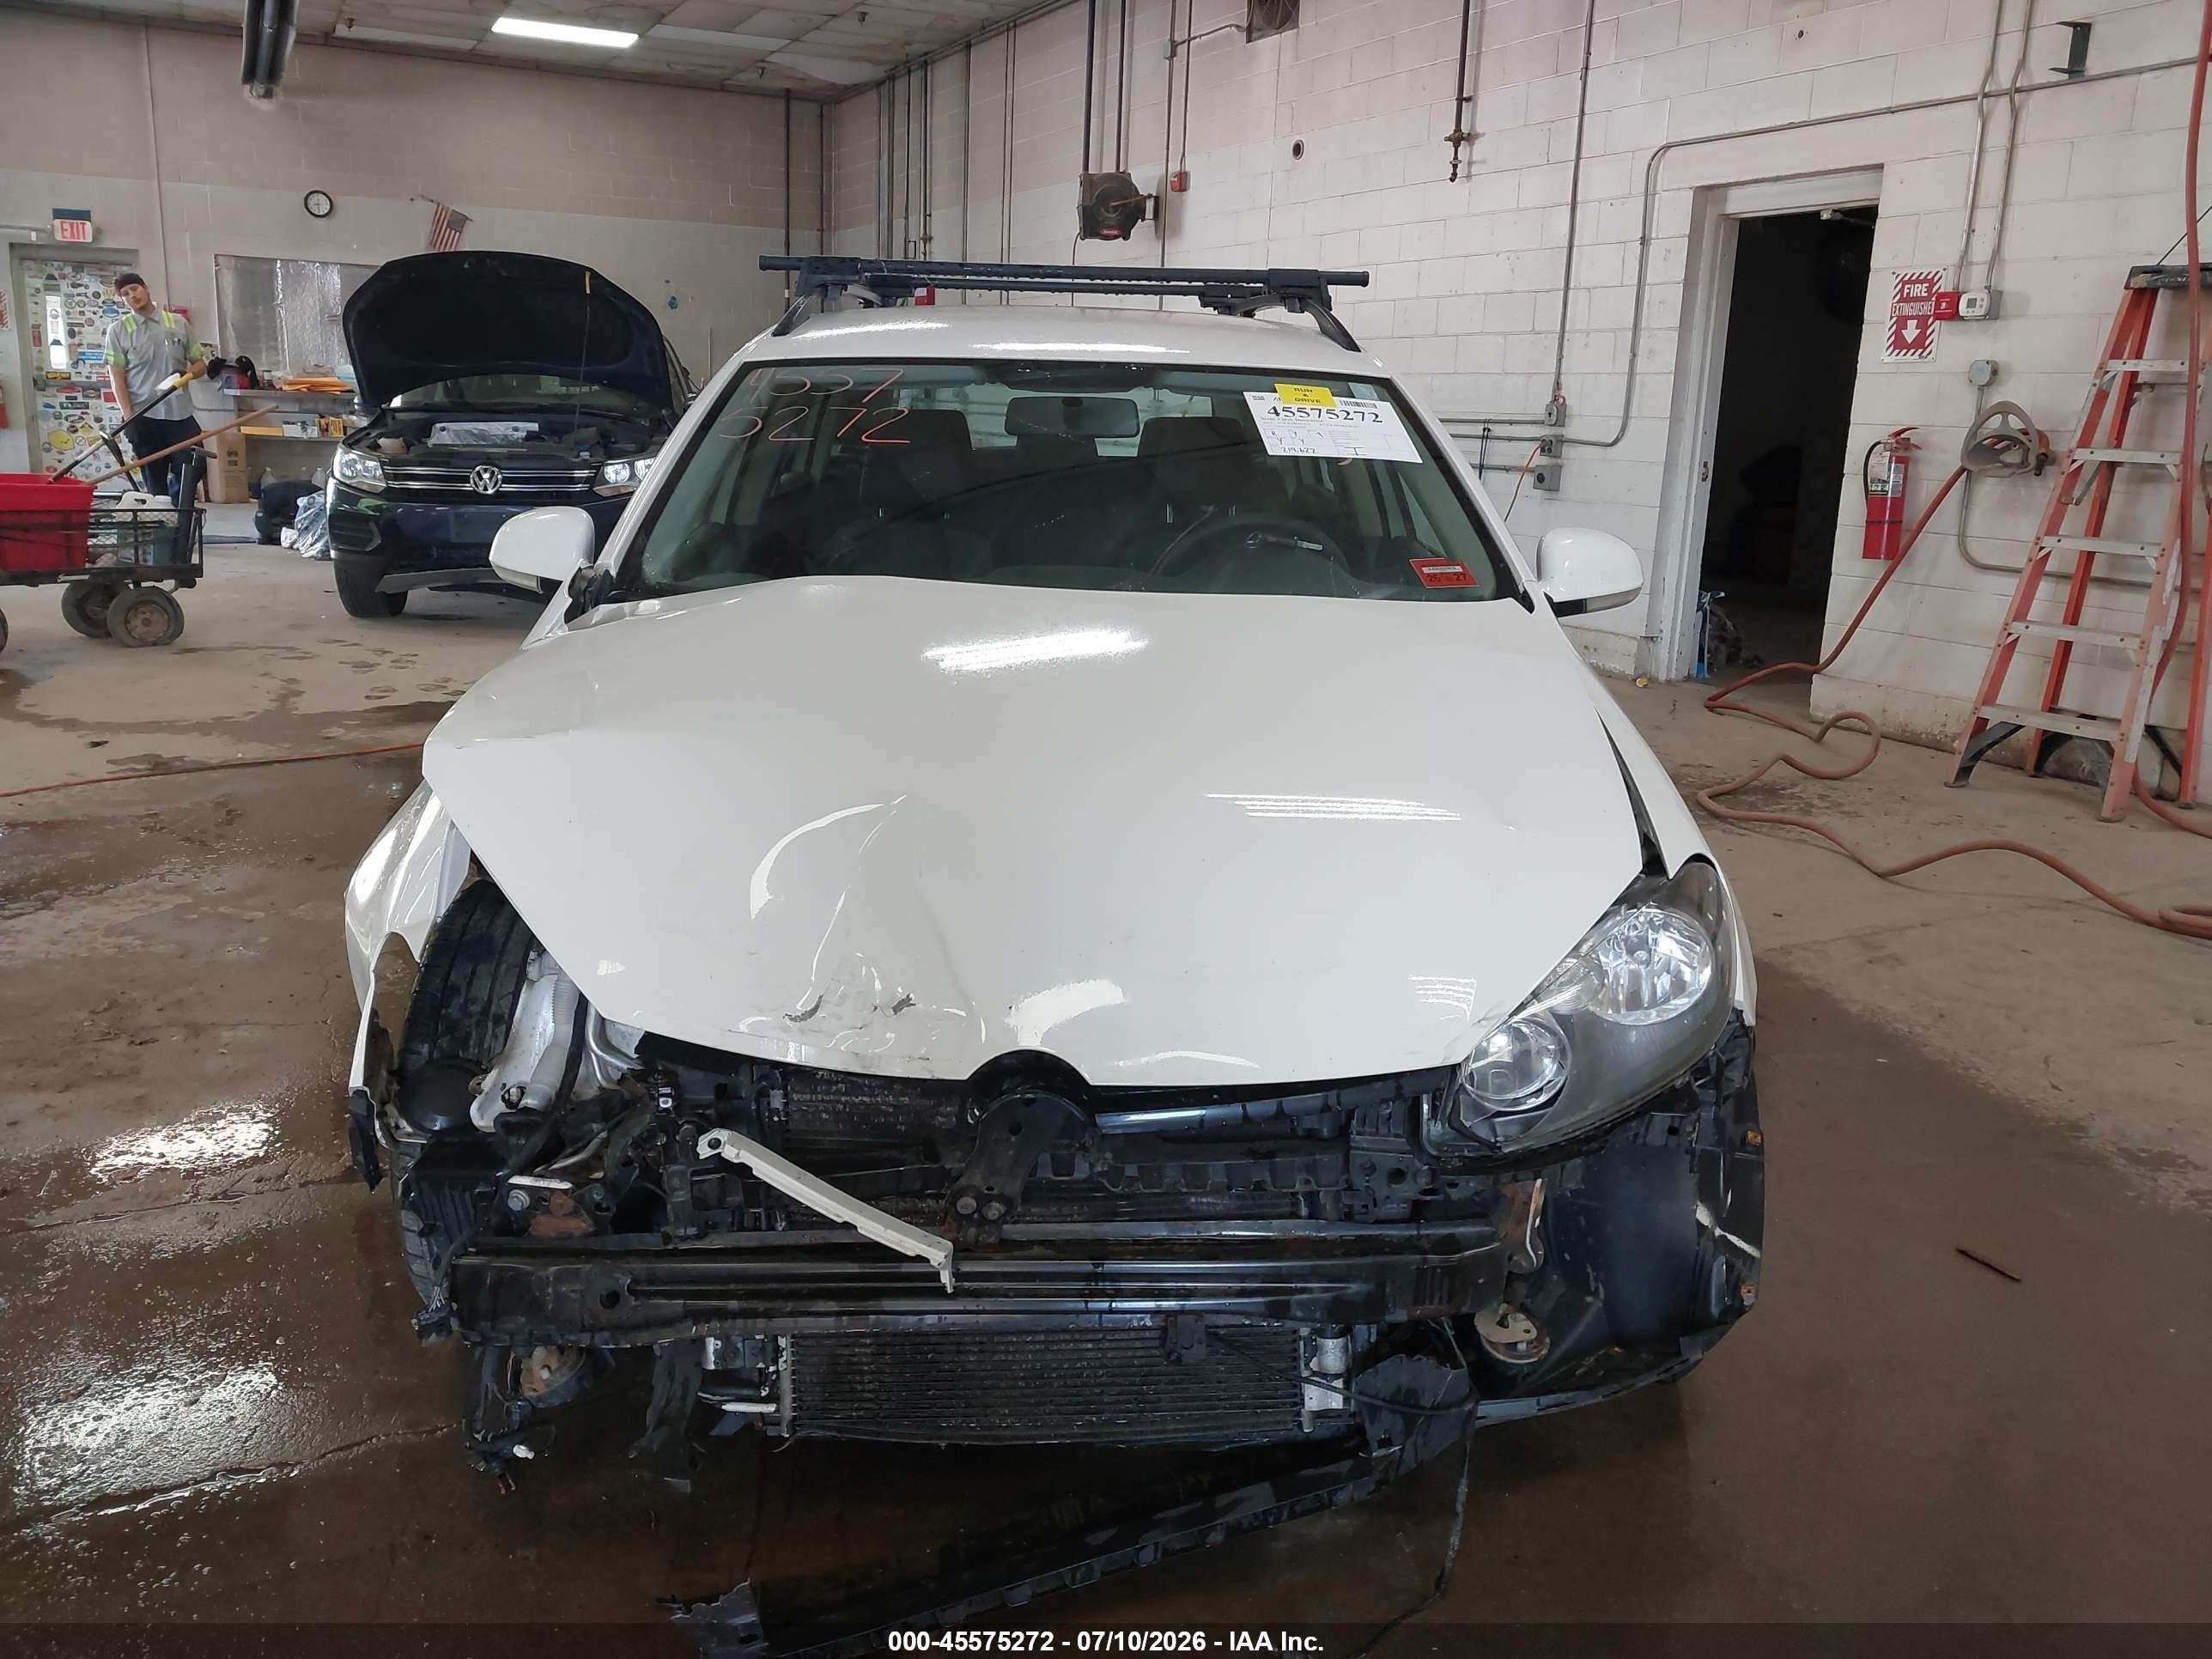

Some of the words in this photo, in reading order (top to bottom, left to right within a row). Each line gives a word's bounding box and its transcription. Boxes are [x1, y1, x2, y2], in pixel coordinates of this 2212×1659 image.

[60, 220, 87, 240] EXIT
[1904, 283, 1929, 298] FIRE
[1892, 301, 1934, 317] EXTINGUISHE
[720, 405, 911, 443] 5272
[1267, 405, 1384, 424] 45575272
